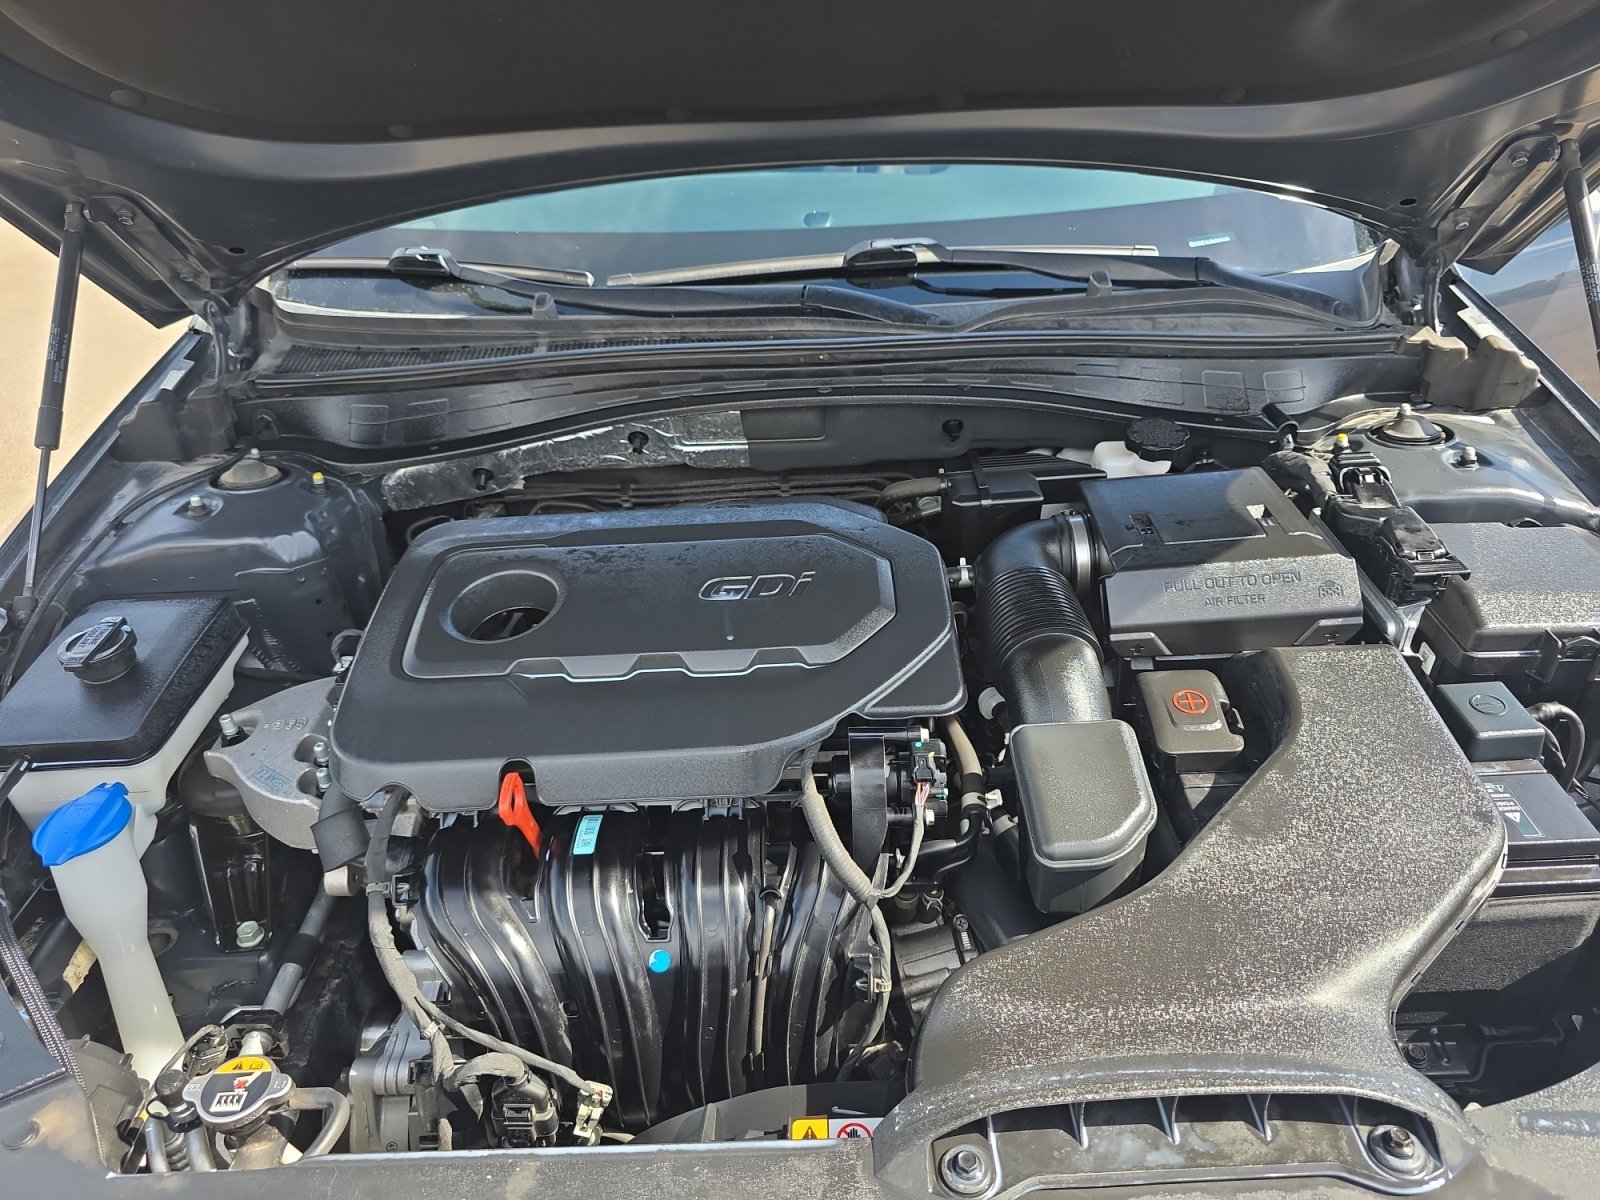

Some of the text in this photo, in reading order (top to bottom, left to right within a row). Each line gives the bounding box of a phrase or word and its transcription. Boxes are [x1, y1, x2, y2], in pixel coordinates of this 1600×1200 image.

[1163, 571, 1302, 593] PULL OUT TO OPEN
[1204, 594, 1266, 608] AIR FILTER
